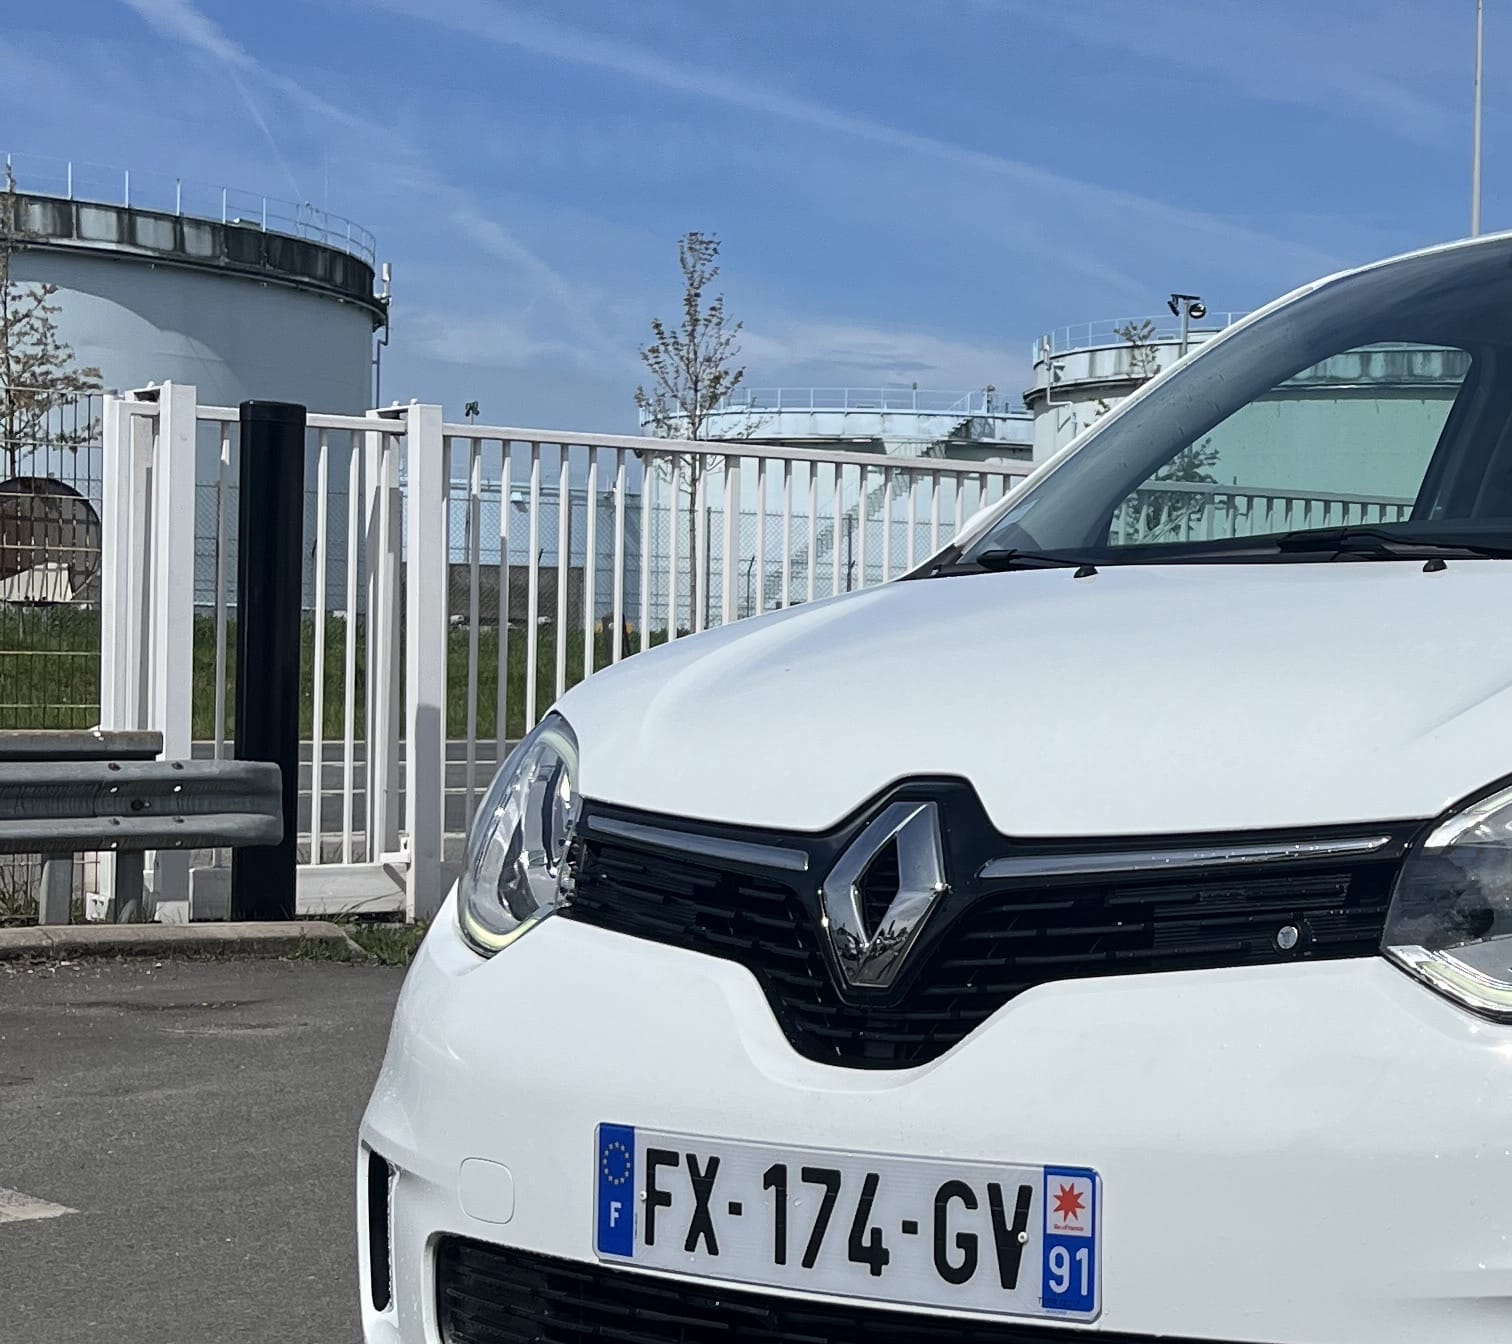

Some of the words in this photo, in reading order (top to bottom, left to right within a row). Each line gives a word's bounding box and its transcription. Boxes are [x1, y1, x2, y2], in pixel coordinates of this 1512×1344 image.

[610, 1201, 622, 1228] F
[644, 1148, 1033, 1290] FX-174-GV
[1049, 1245, 1088, 1296] 91
